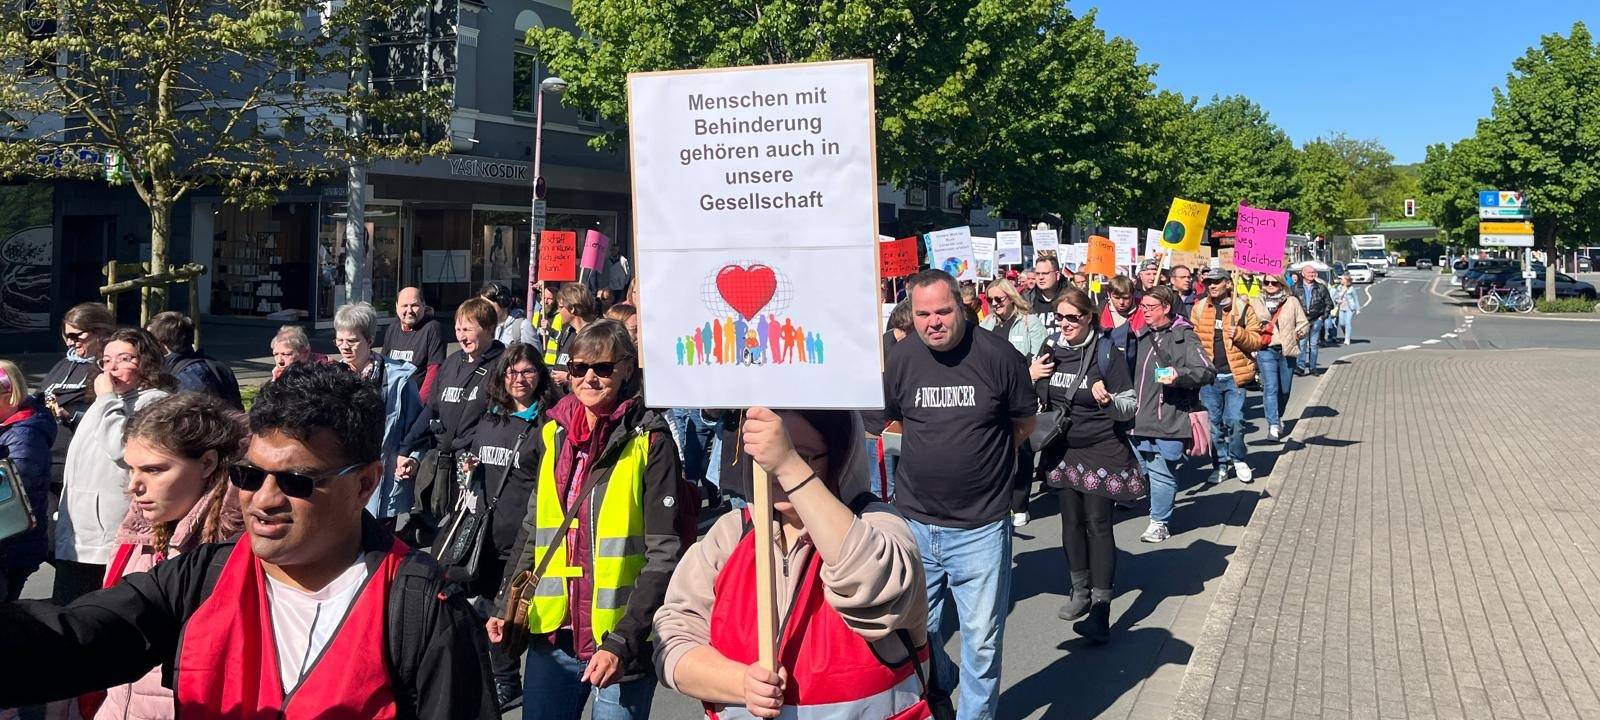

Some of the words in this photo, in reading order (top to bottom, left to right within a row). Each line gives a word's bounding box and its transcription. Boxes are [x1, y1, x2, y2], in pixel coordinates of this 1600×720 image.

[688, 91, 788, 111] Menschen
[795, 87, 827, 104] mit
[694, 116, 822, 136] Behinderung
[679, 143, 759, 166] gehören
[766, 139, 814, 158] auch
[821, 138, 840, 155] in
[725, 168, 794, 185] unsere
[699, 190, 824, 211] Gesellschaft
[1239, 212, 1276, 228] schen
[1240, 250, 1282, 269] gleichen
[914, 385, 976, 408] #INKLUENCER
